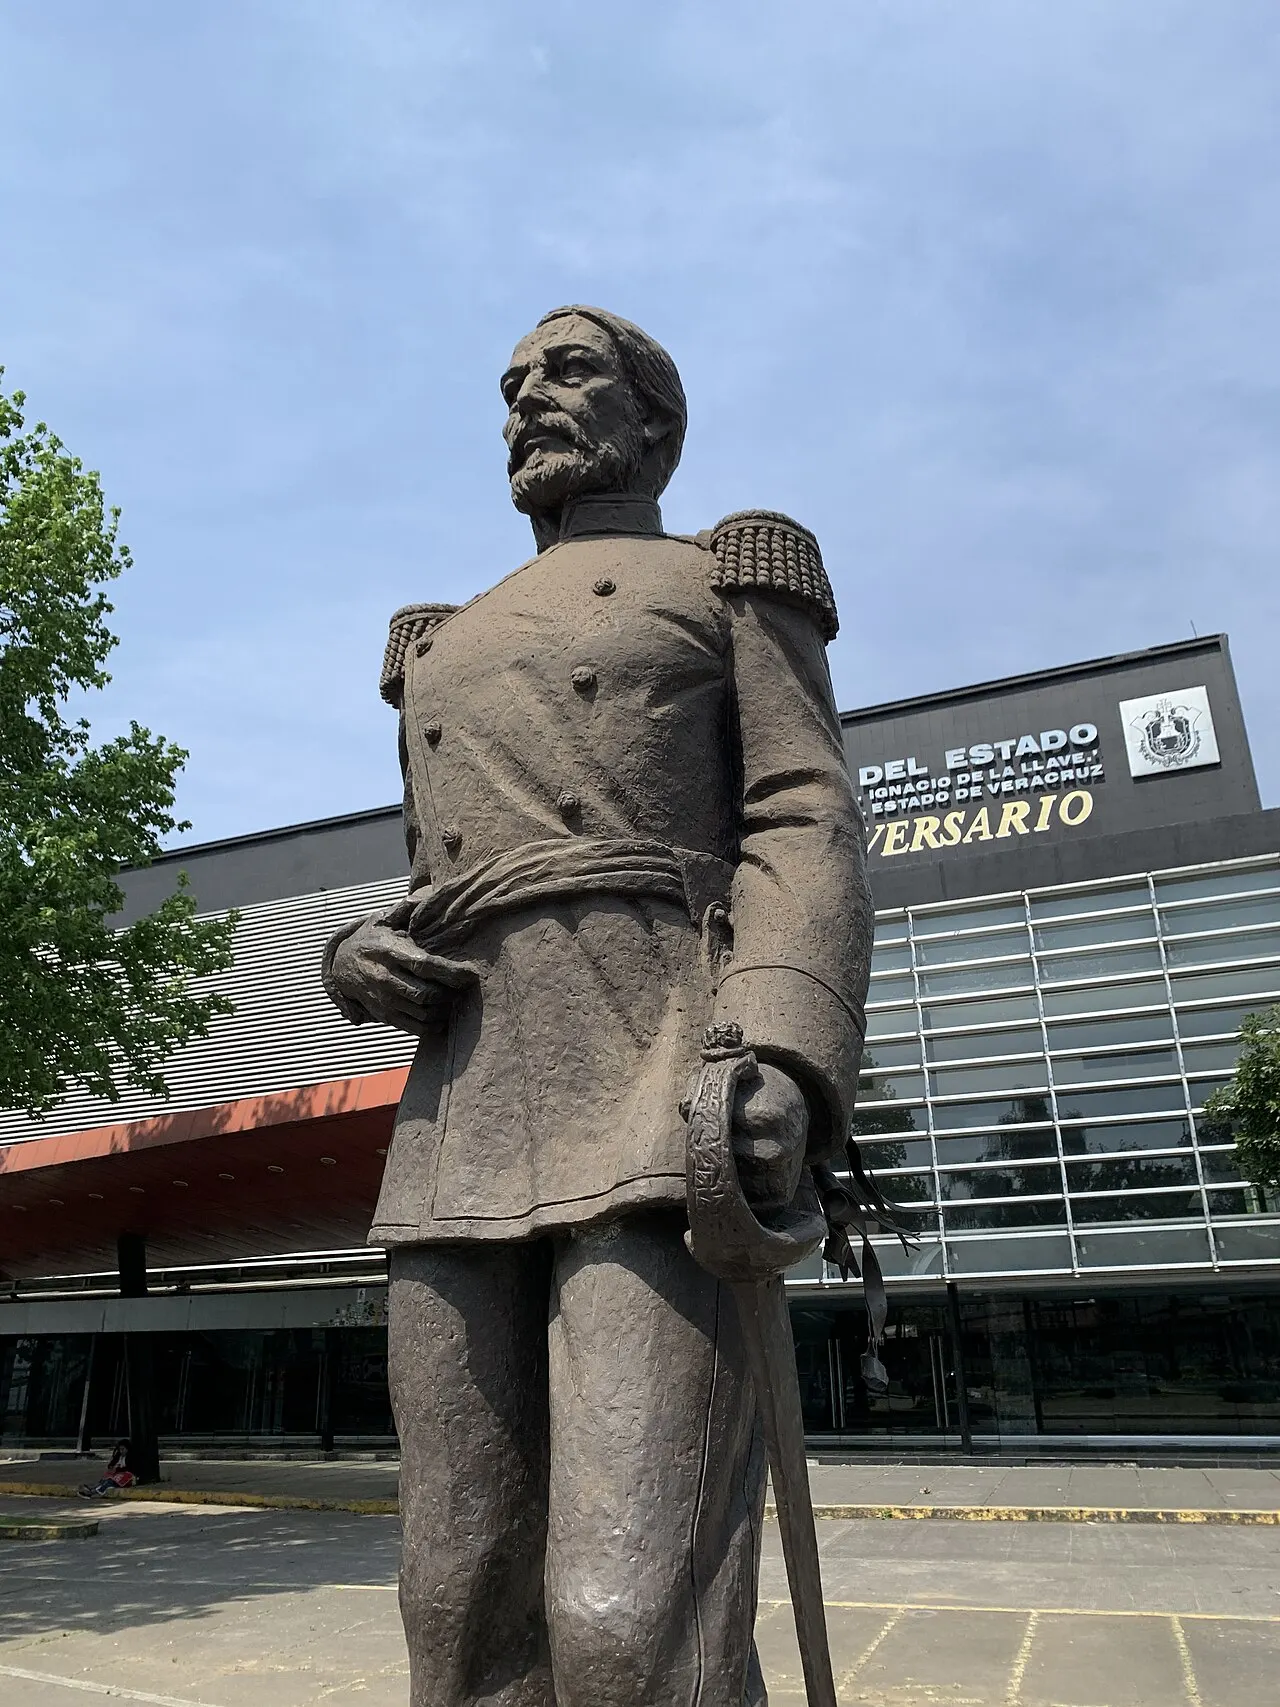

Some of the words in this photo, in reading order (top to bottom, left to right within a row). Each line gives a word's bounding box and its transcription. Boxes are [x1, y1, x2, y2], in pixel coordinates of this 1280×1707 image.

[859, 757, 928, 787] DEL
[944, 723, 1098, 770] ESTADO
[868, 776, 951, 800] IGNACIO
[956, 770, 984, 785] DE
[989, 765, 1016, 780] LA
[871, 790, 950, 814] ESTADO
[955, 785, 983, 801] DE
[987, 763, 1104, 795] VERACRUZ
